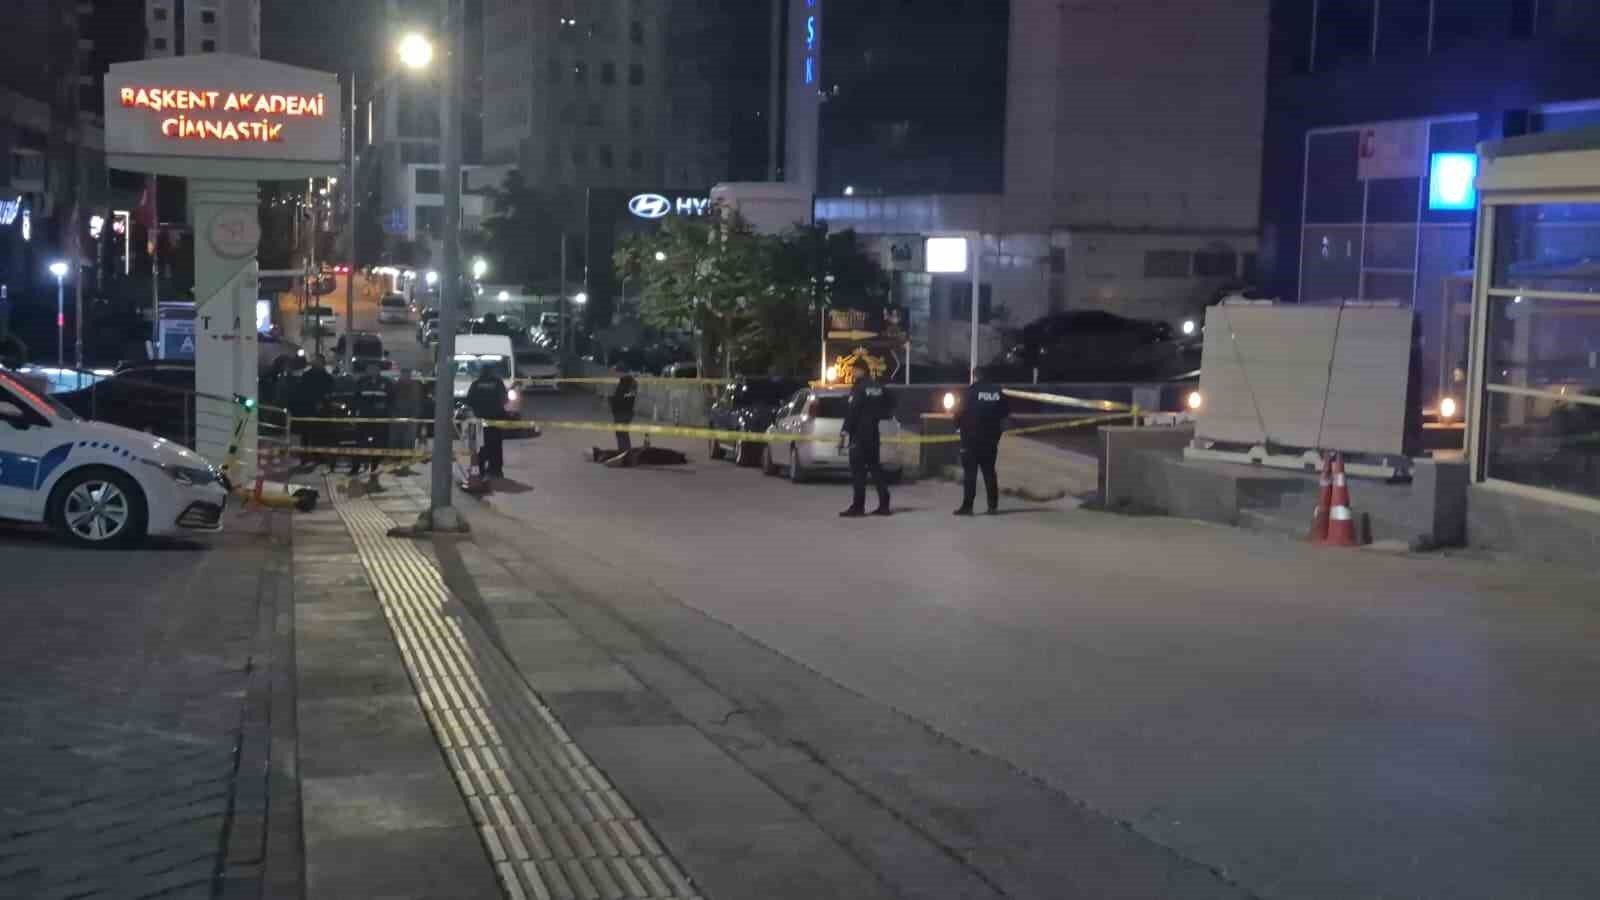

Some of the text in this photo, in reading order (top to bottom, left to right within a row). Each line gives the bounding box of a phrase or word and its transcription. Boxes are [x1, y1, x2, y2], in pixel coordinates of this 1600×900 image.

[120, 87, 324, 116] BAŞKENT AKADEMİ
[676, 197, 711, 216] HY
